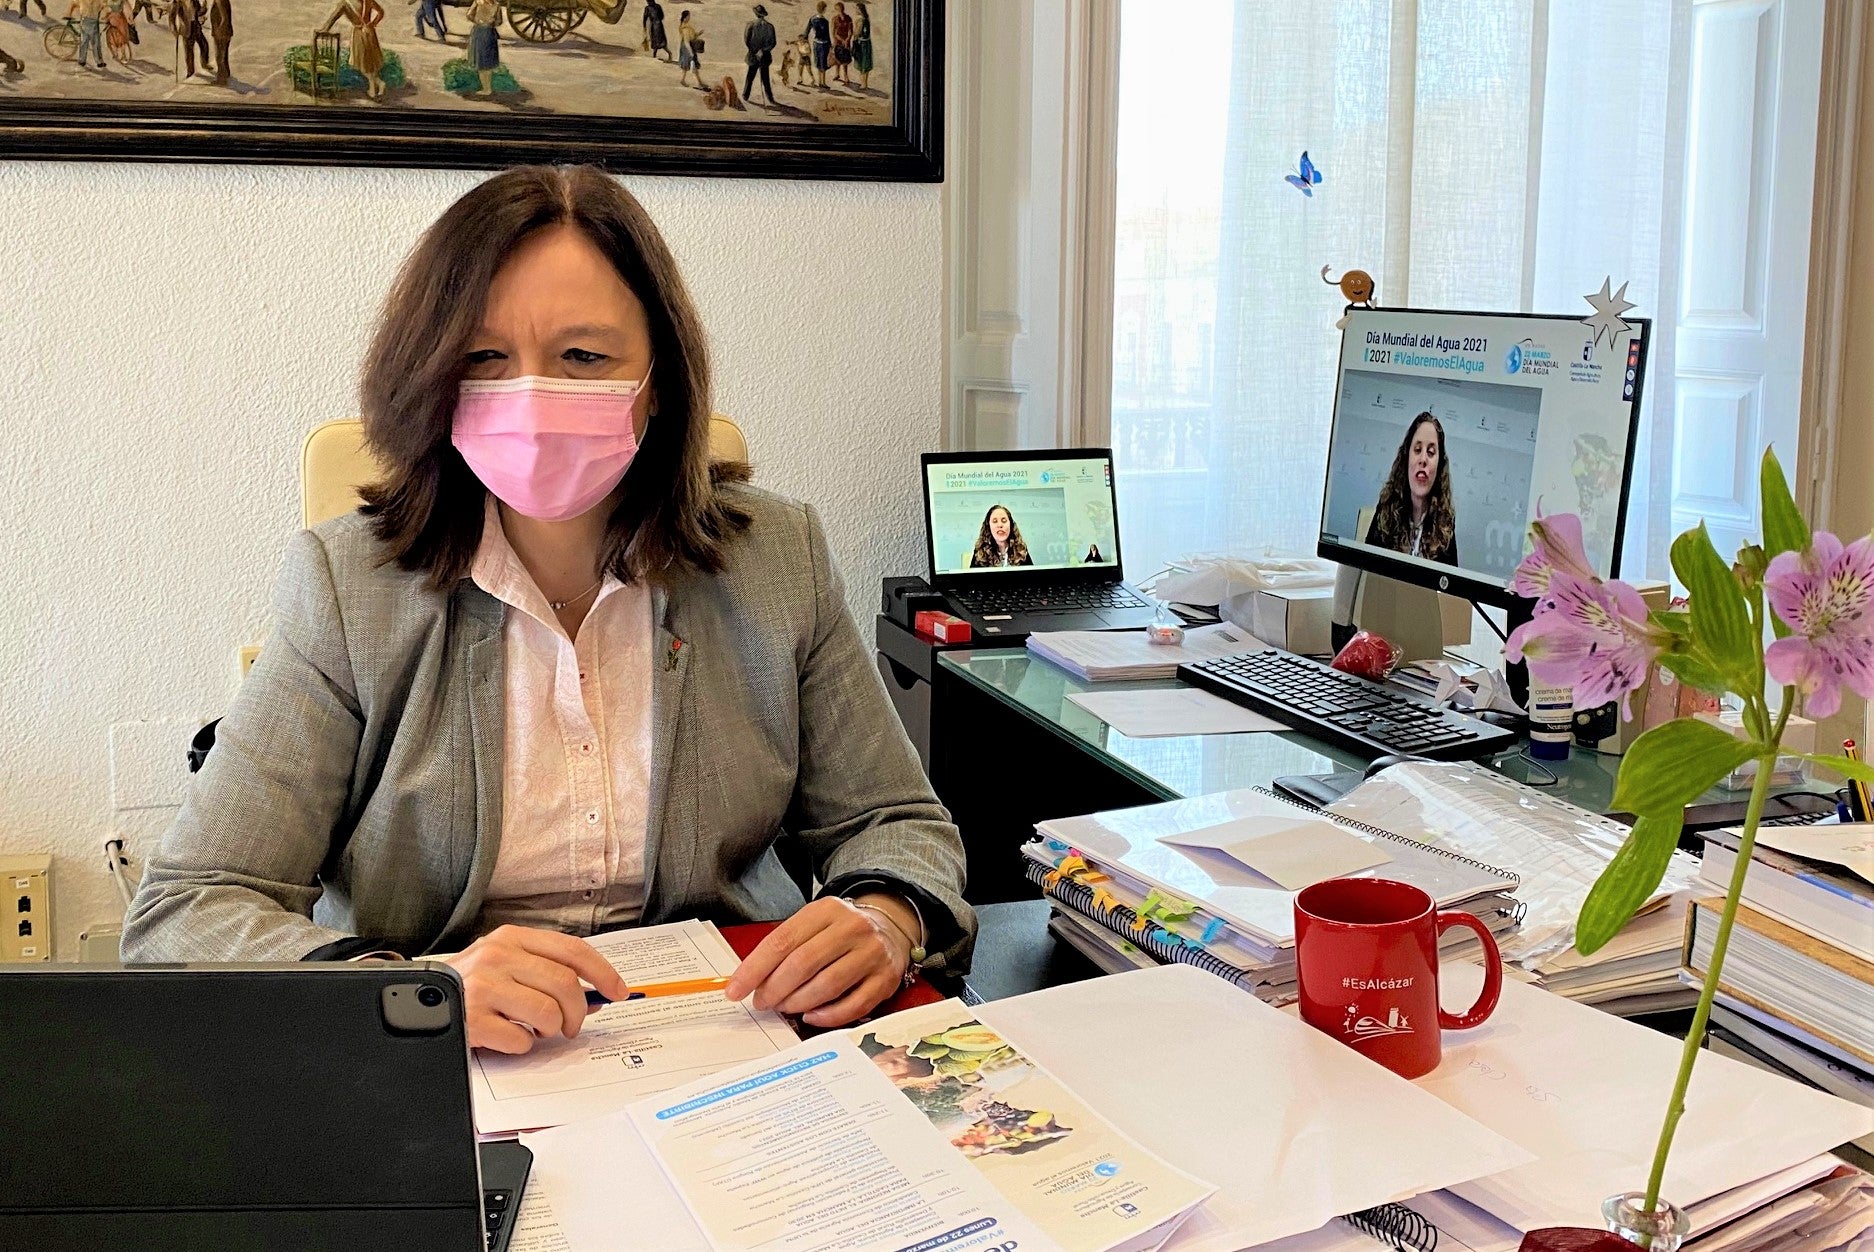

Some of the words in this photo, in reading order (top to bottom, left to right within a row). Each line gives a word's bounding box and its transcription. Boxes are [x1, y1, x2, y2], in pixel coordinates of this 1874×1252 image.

[1366, 332, 1380, 344] Día
[1382, 332, 1418, 347] Mundial
[1420, 335, 1434, 348] del
[1436, 336, 1460, 352] Agua
[1463, 338, 1487, 352] 2021
[1370, 350, 1391, 363] 2021
[1394, 352, 1484, 374] #ValoremosElAgua
[1534, 360, 1559, 369] MUNDIAL
[1342, 978, 1414, 990] #EsAlcázar
[808, 1053, 831, 1064] HAZ
[778, 1061, 810, 1075] CLICK
[724, 1081, 753, 1095] PARA
[660, 1091, 725, 1118] INSCRIBIRTE
[1049, 1175, 1075, 1188] AGUA
[962, 1218, 993, 1233] Lunes
[935, 1235, 950, 1244] de
[948, 1229, 964, 1239] 22
